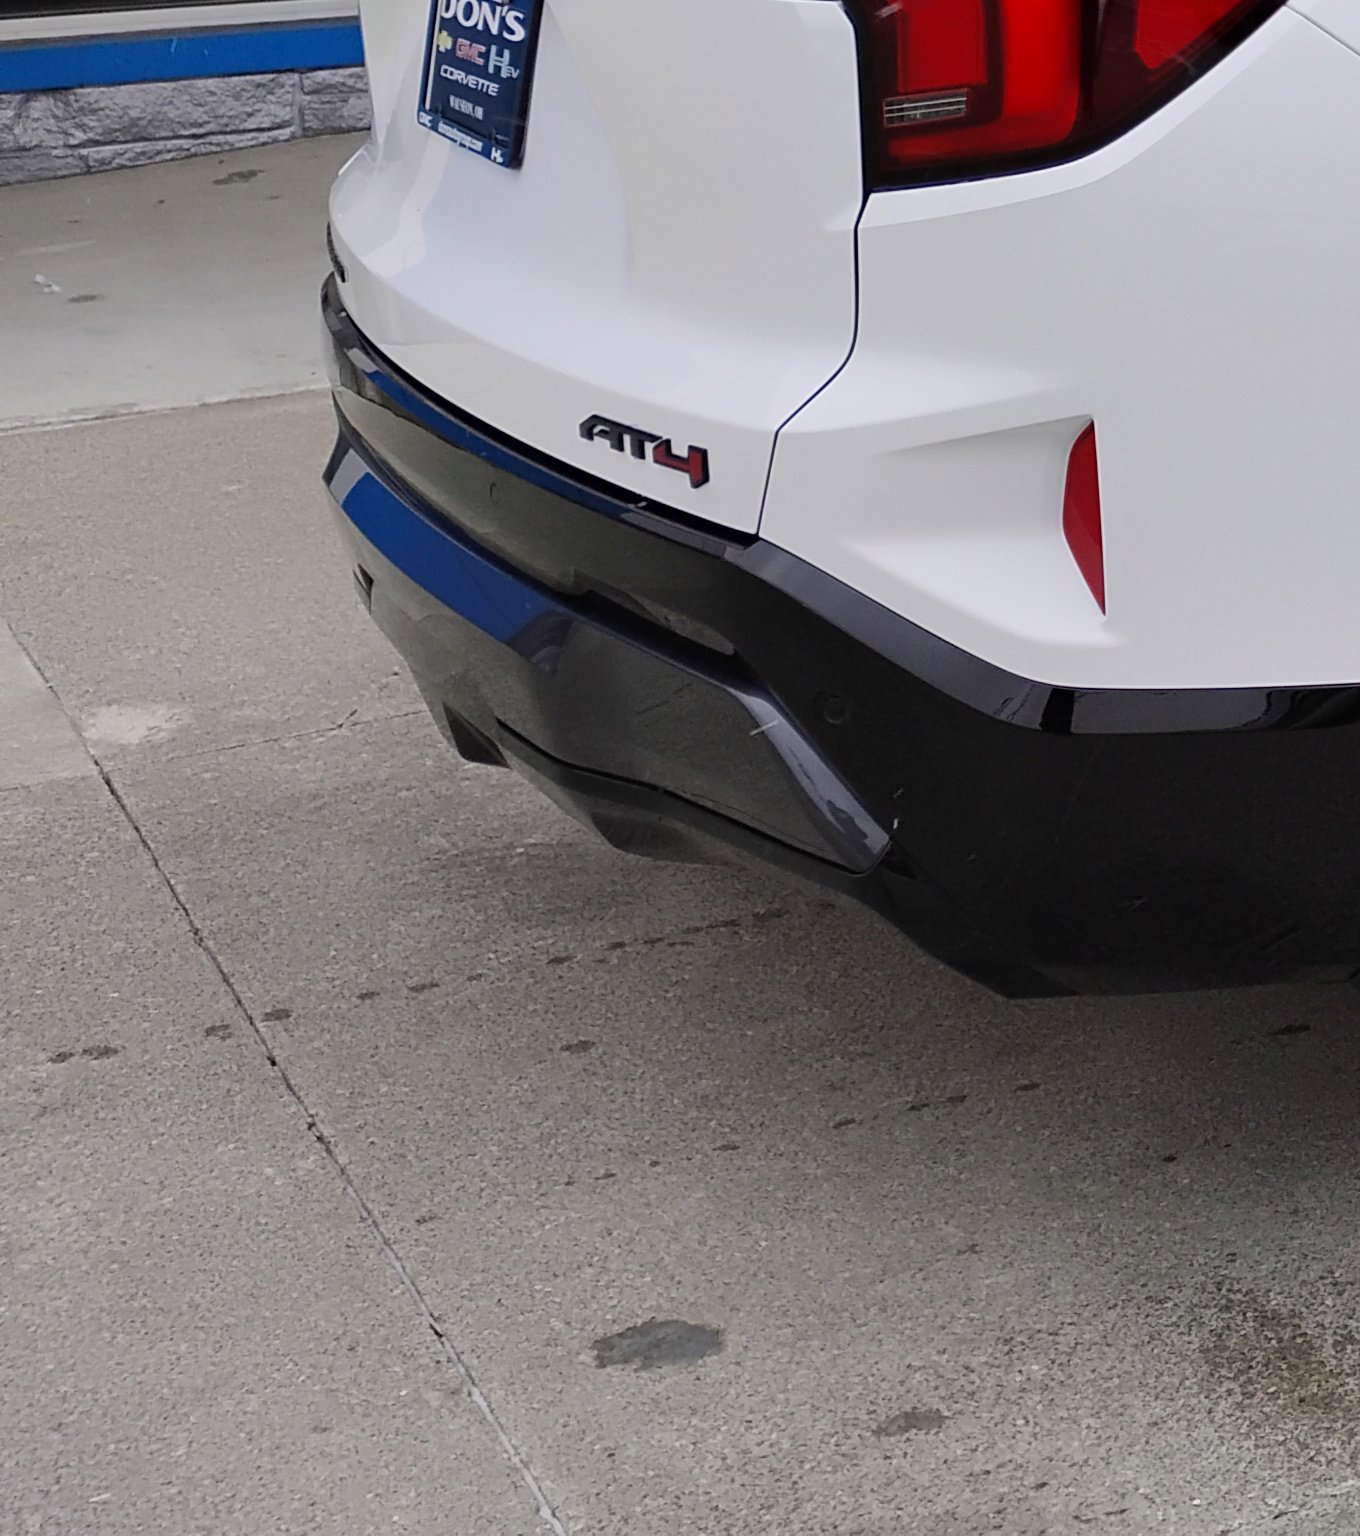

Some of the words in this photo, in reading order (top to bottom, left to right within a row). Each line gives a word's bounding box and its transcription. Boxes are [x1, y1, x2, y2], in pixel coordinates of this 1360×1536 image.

[455, 37, 487, 66] GMC
[440, 64, 501, 97] CORVETTE
[579, 414, 710, 489] AT4
